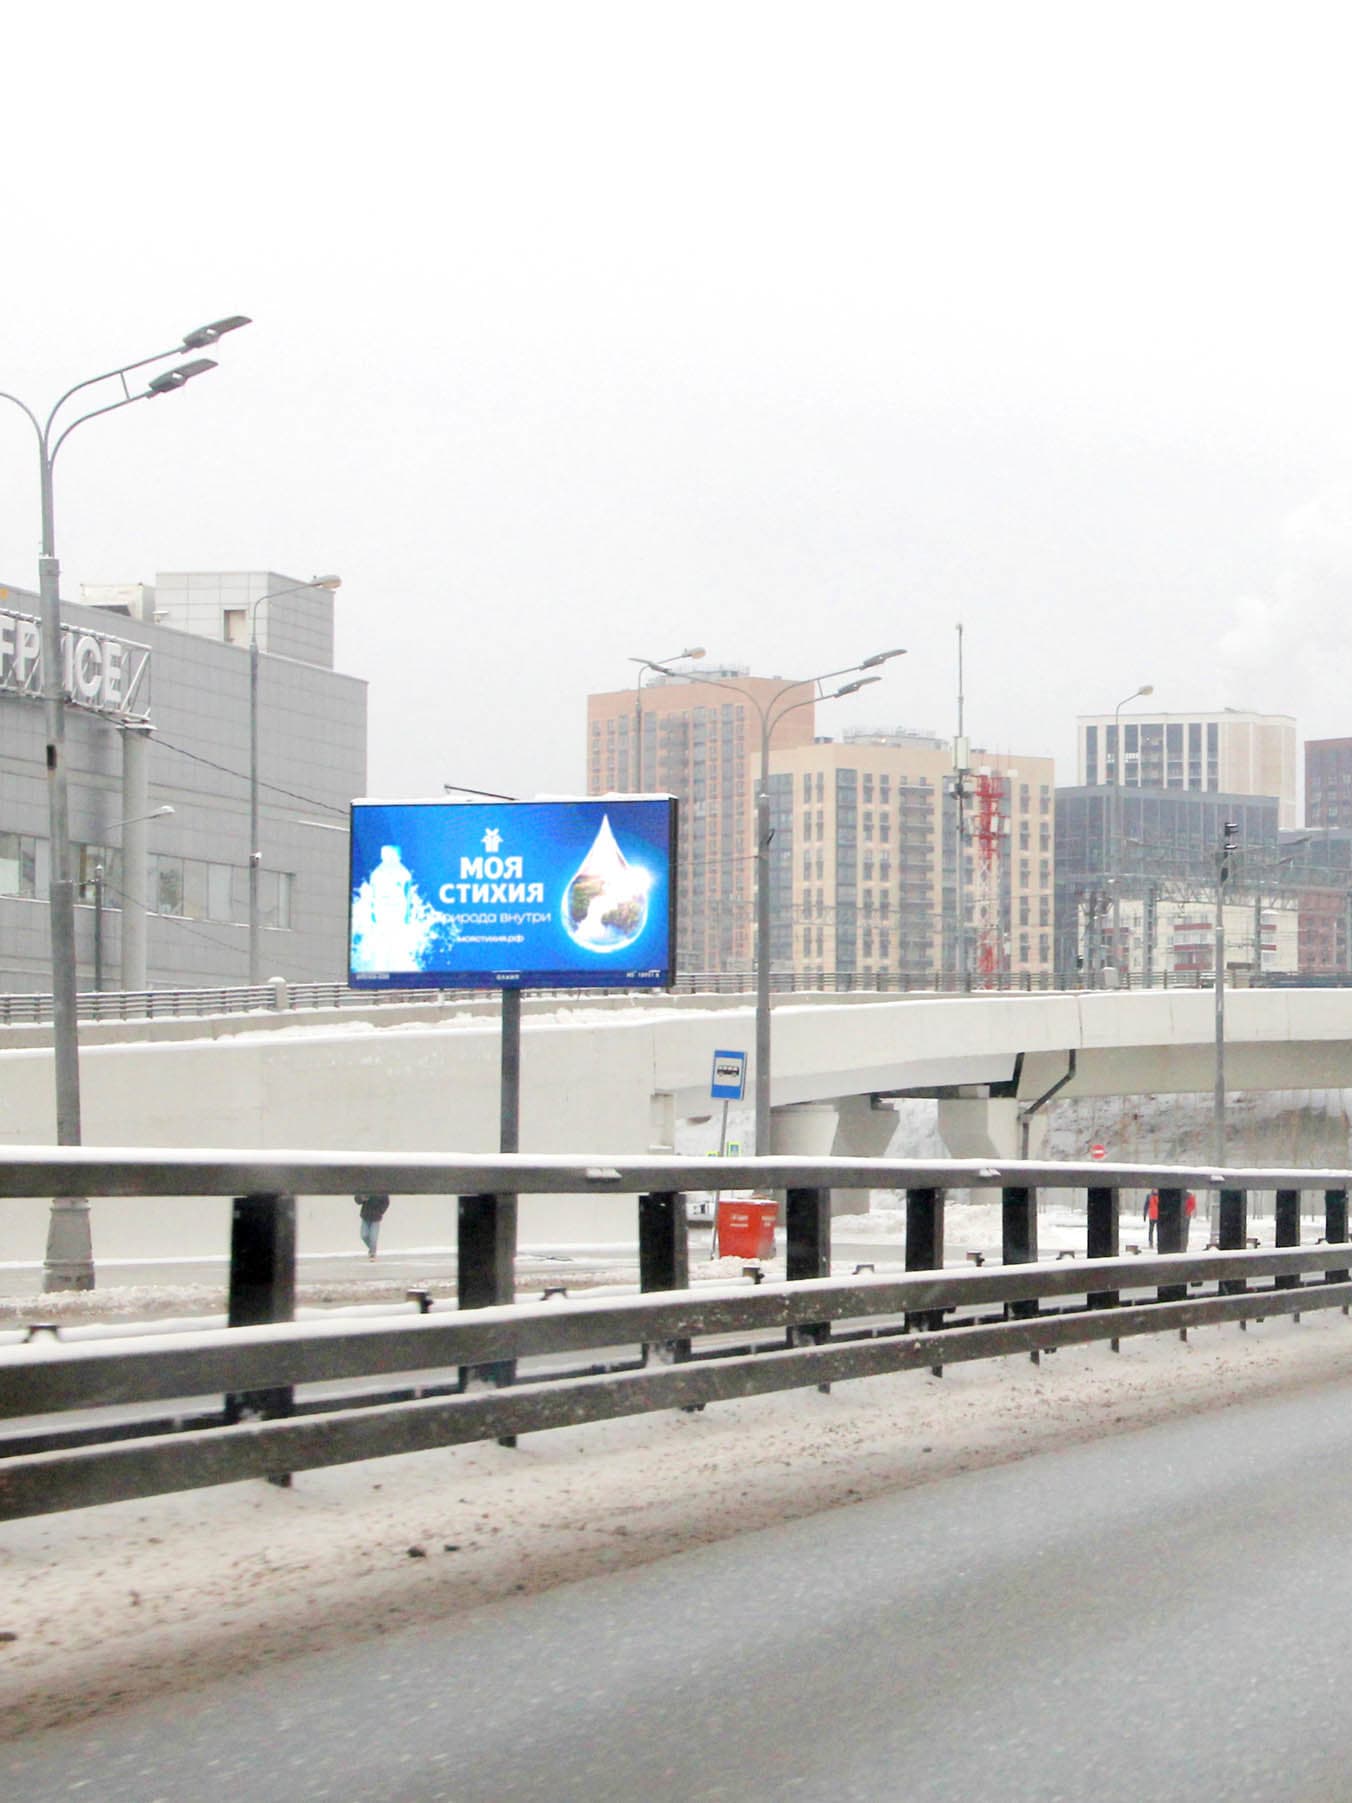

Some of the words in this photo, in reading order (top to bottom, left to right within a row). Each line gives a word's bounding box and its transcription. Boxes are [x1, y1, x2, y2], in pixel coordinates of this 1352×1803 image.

[0, 615, 122, 703] FPICE
[460, 856, 523, 879] МОЯ
[439, 883, 544, 904] СТИХИЯ
[437, 912, 497, 924] рирода
[500, 912, 552, 925] внутри
